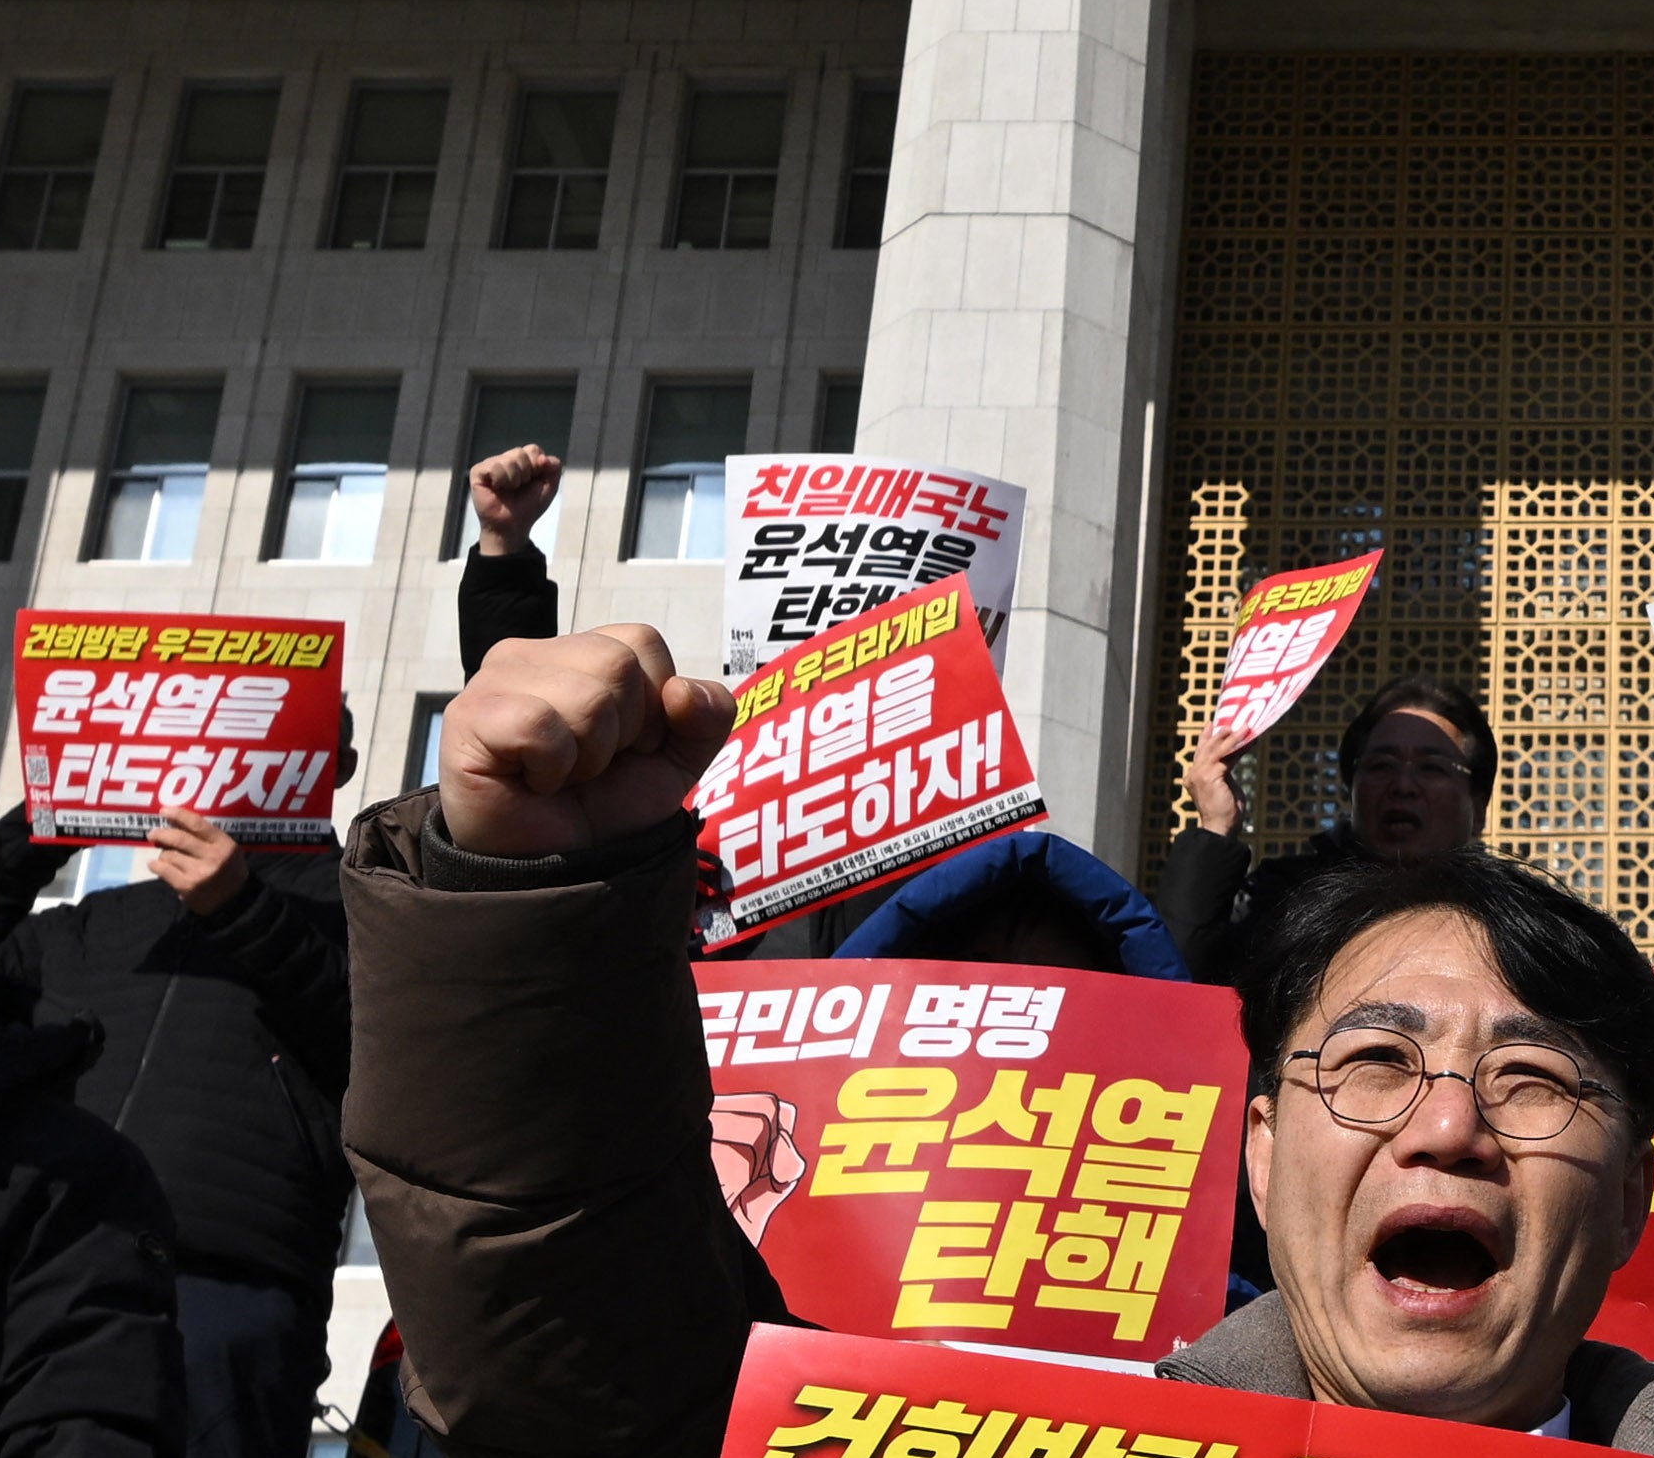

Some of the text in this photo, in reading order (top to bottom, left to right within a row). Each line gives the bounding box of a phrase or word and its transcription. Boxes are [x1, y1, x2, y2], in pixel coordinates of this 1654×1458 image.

[742, 463, 1009, 541] 친일매국노
[737, 522, 978, 584] 윤석열을
[1260, 563, 1373, 616] 우크라개입
[22, 623, 335, 669] 건희방탄 우크라개입
[792, 590, 960, 694] 우크라개입
[32, 669, 290, 740] 윤석열을
[691, 654, 936, 819] 윤석열을
[51, 743, 331, 812] 타도하자!
[719, 710, 1003, 888] 타도하자!
[821, 846, 878, 881] 촛불대행진
[902, 828, 931, 850] 토요일
[698, 983, 1066, 1068] 국민의 명령
[808, 1067, 1222, 1209] 윤석열
[891, 1201, 1182, 1342] 탄핵
